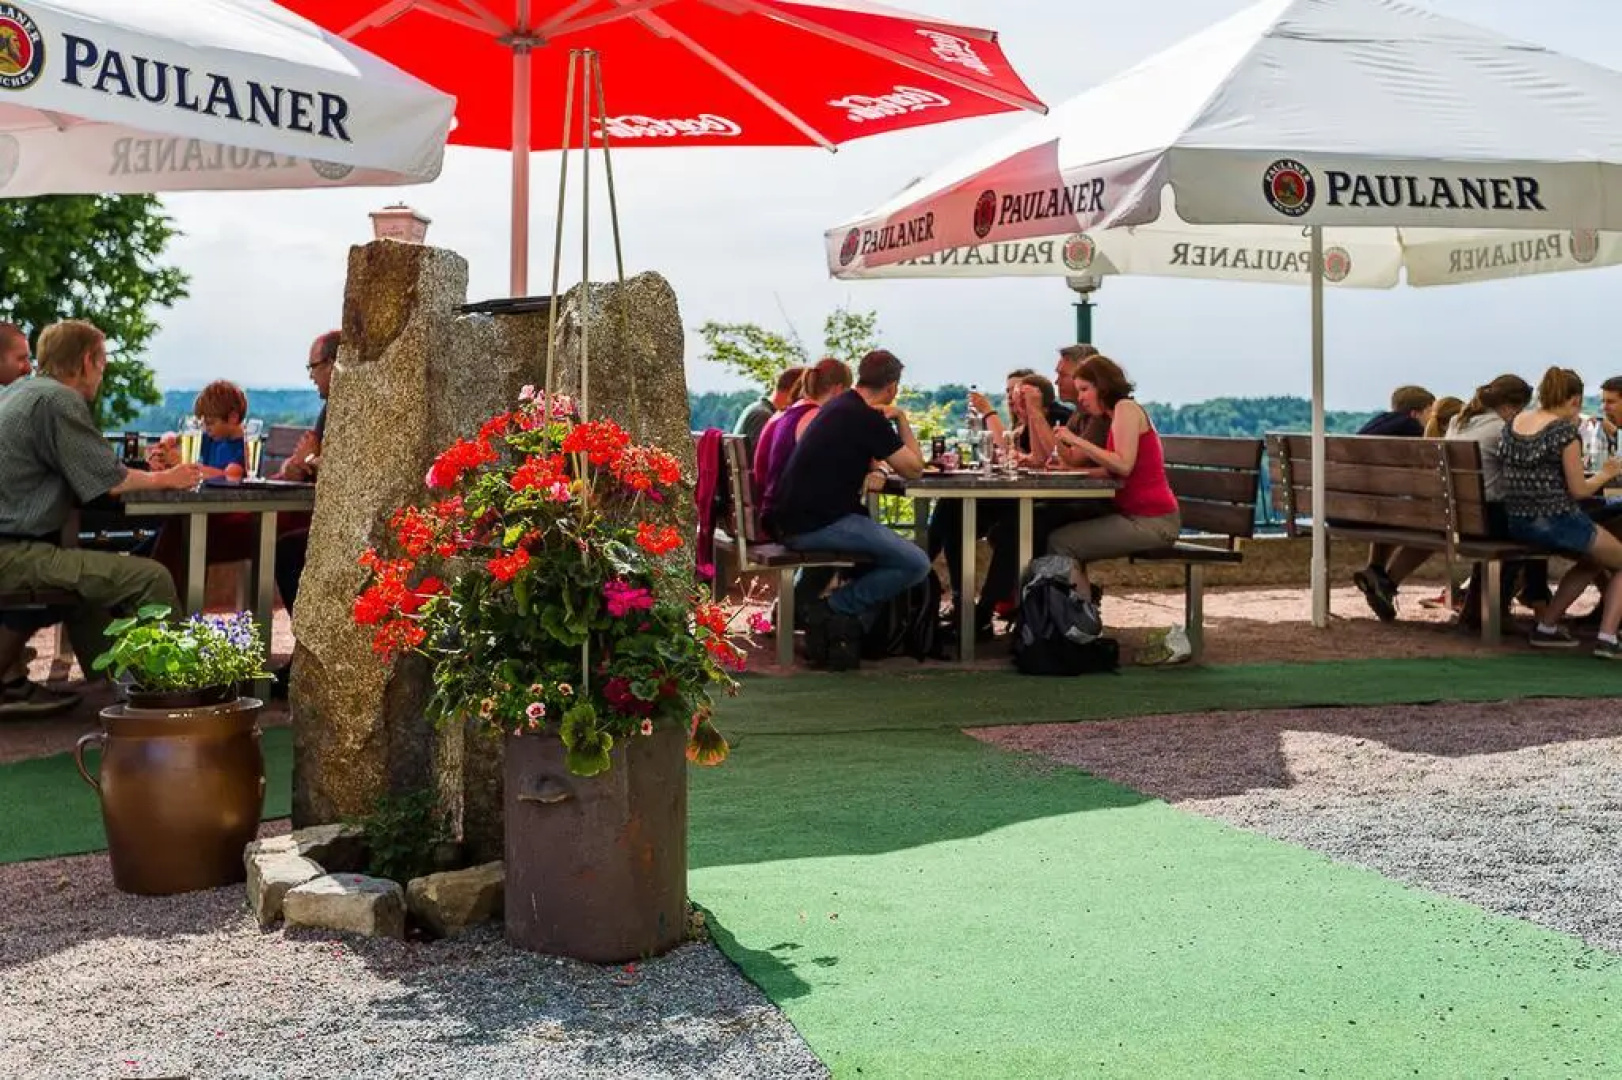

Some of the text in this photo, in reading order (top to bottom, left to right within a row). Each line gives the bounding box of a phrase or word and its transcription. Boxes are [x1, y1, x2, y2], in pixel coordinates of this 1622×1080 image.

[61, 33, 353, 143] PAULANER
[998, 177, 1106, 226] PAULANER
[1324, 170, 1547, 210] PAULANER
[860, 211, 934, 255] PAULANER
